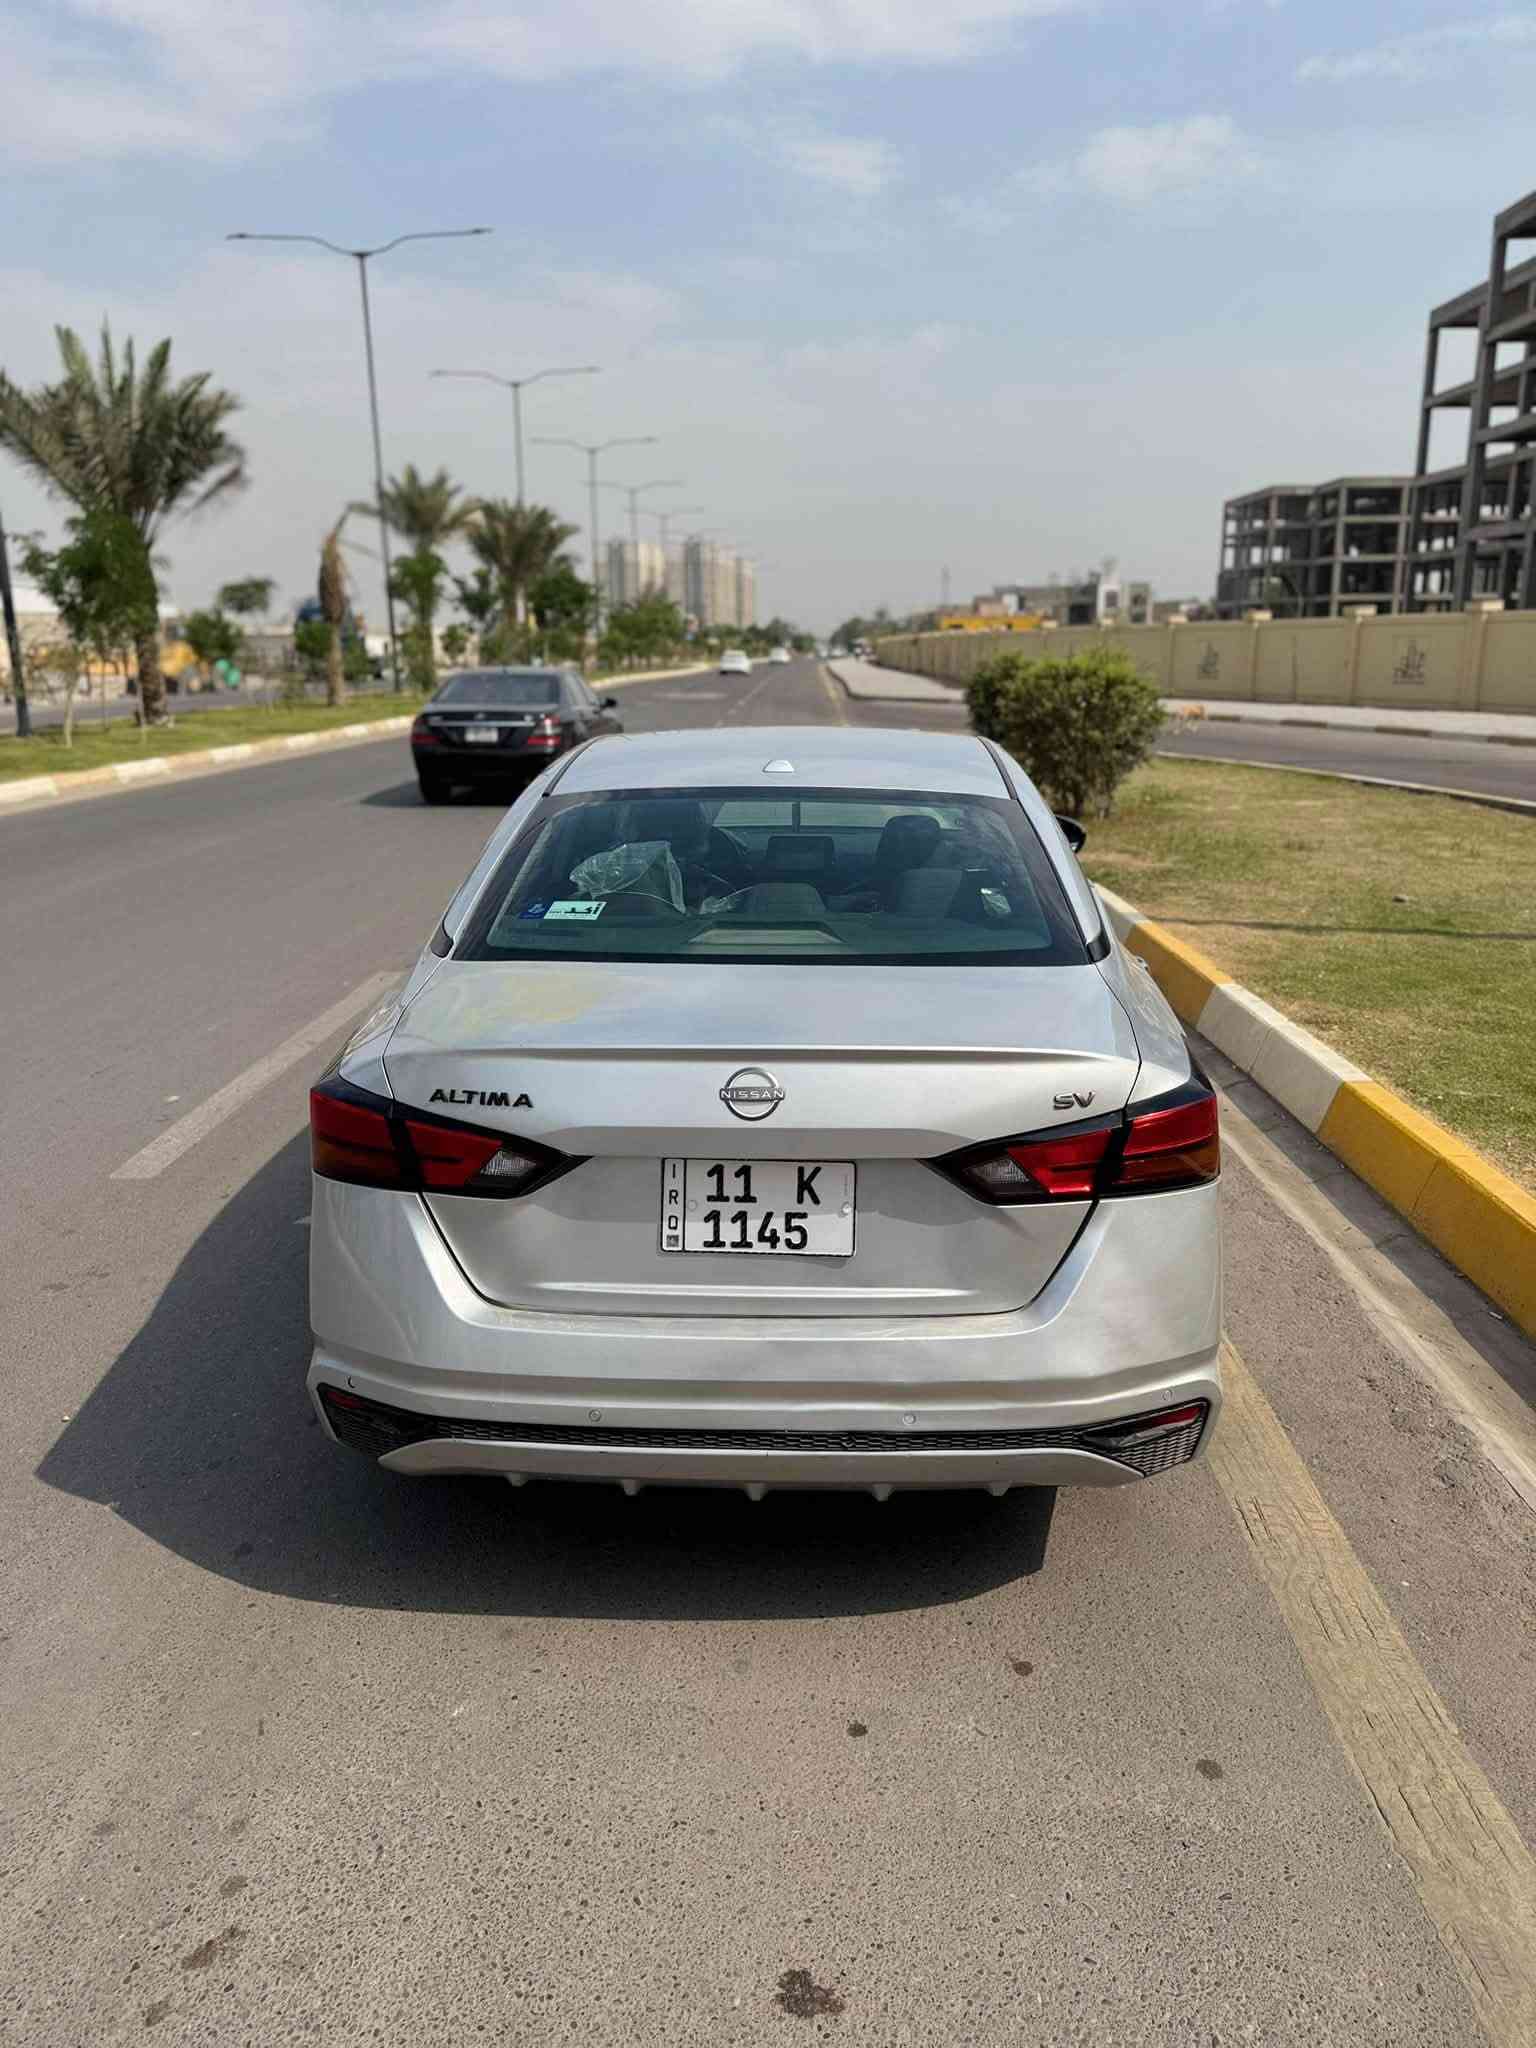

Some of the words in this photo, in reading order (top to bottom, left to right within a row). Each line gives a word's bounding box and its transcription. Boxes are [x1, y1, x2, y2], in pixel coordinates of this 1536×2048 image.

[429, 1088, 534, 1108] ALTIMA
[720, 1088, 784, 1099] NISSAN
[1053, 1091, 1096, 1110] SV
[706, 1163, 757, 1203] 11
[796, 1166, 822, 1205] K
[702, 1209, 808, 1250] 1145
